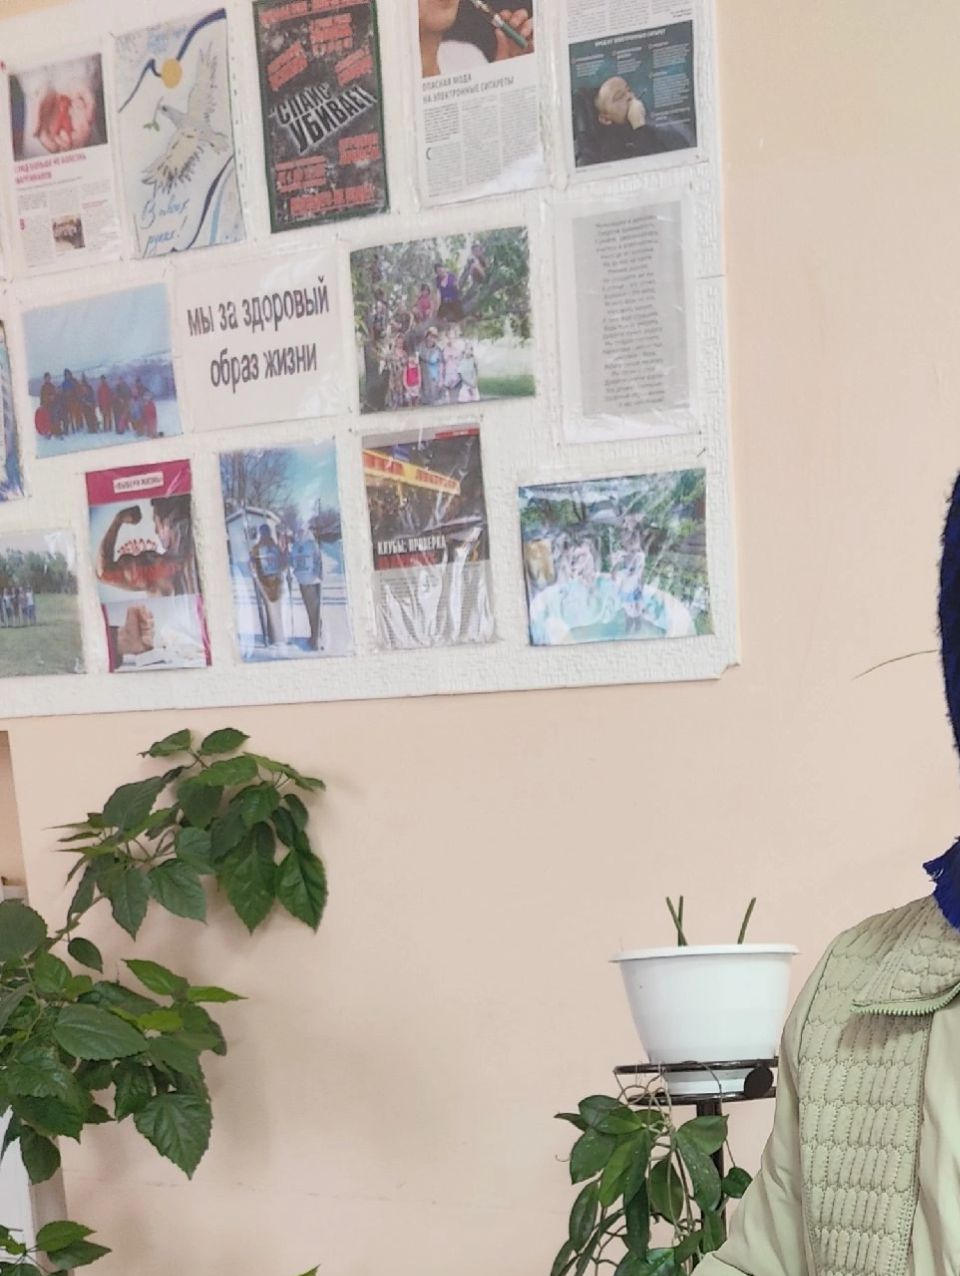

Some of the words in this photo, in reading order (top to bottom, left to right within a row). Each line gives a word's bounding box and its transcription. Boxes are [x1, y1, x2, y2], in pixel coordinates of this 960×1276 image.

[187, 308, 214, 337] мы
[219, 301, 239, 331] за
[243, 275, 330, 334] здоровый
[210, 348, 259, 394] образ
[264, 342, 318, 378] жизни
